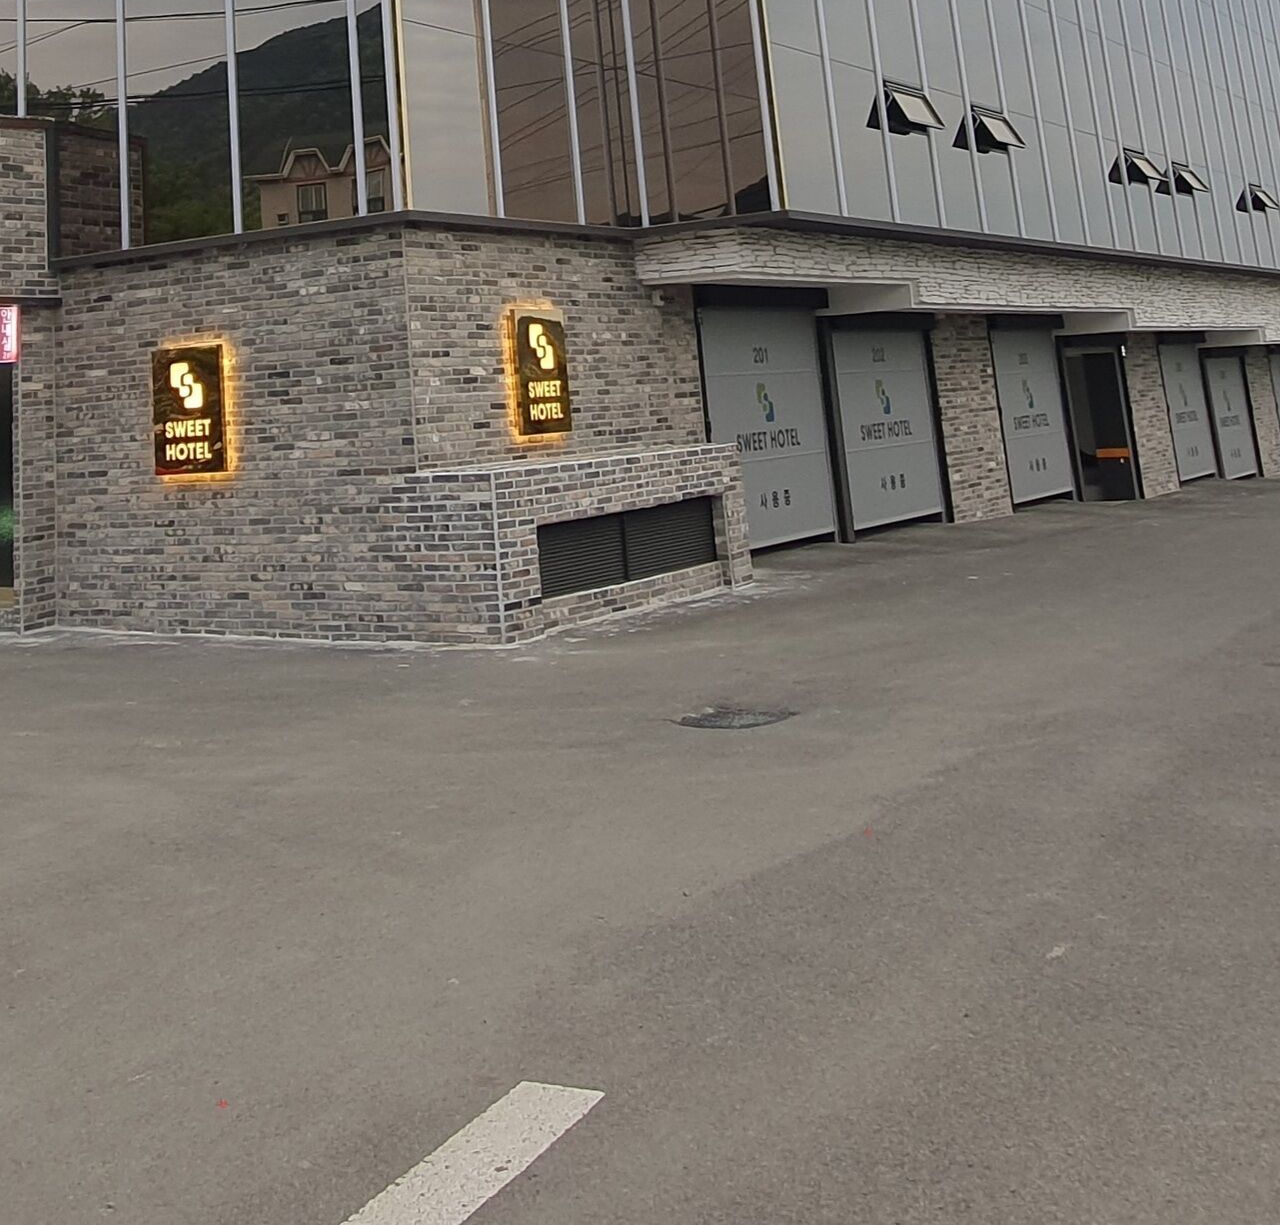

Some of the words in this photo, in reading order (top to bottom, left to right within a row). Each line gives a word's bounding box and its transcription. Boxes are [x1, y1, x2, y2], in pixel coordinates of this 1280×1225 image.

[752, 347, 769, 364] 201
[528, 380, 562, 398] SWEET
[530, 401, 564, 421] HOTEL
[165, 418, 211, 438] SWEET
[860, 422, 886, 441] SWEET
[888, 419, 912, 438] HOTEL
[166, 441, 212, 460] HOTEL
[737, 431, 767, 453] SWEET
[770, 428, 801, 448] HOTEL
